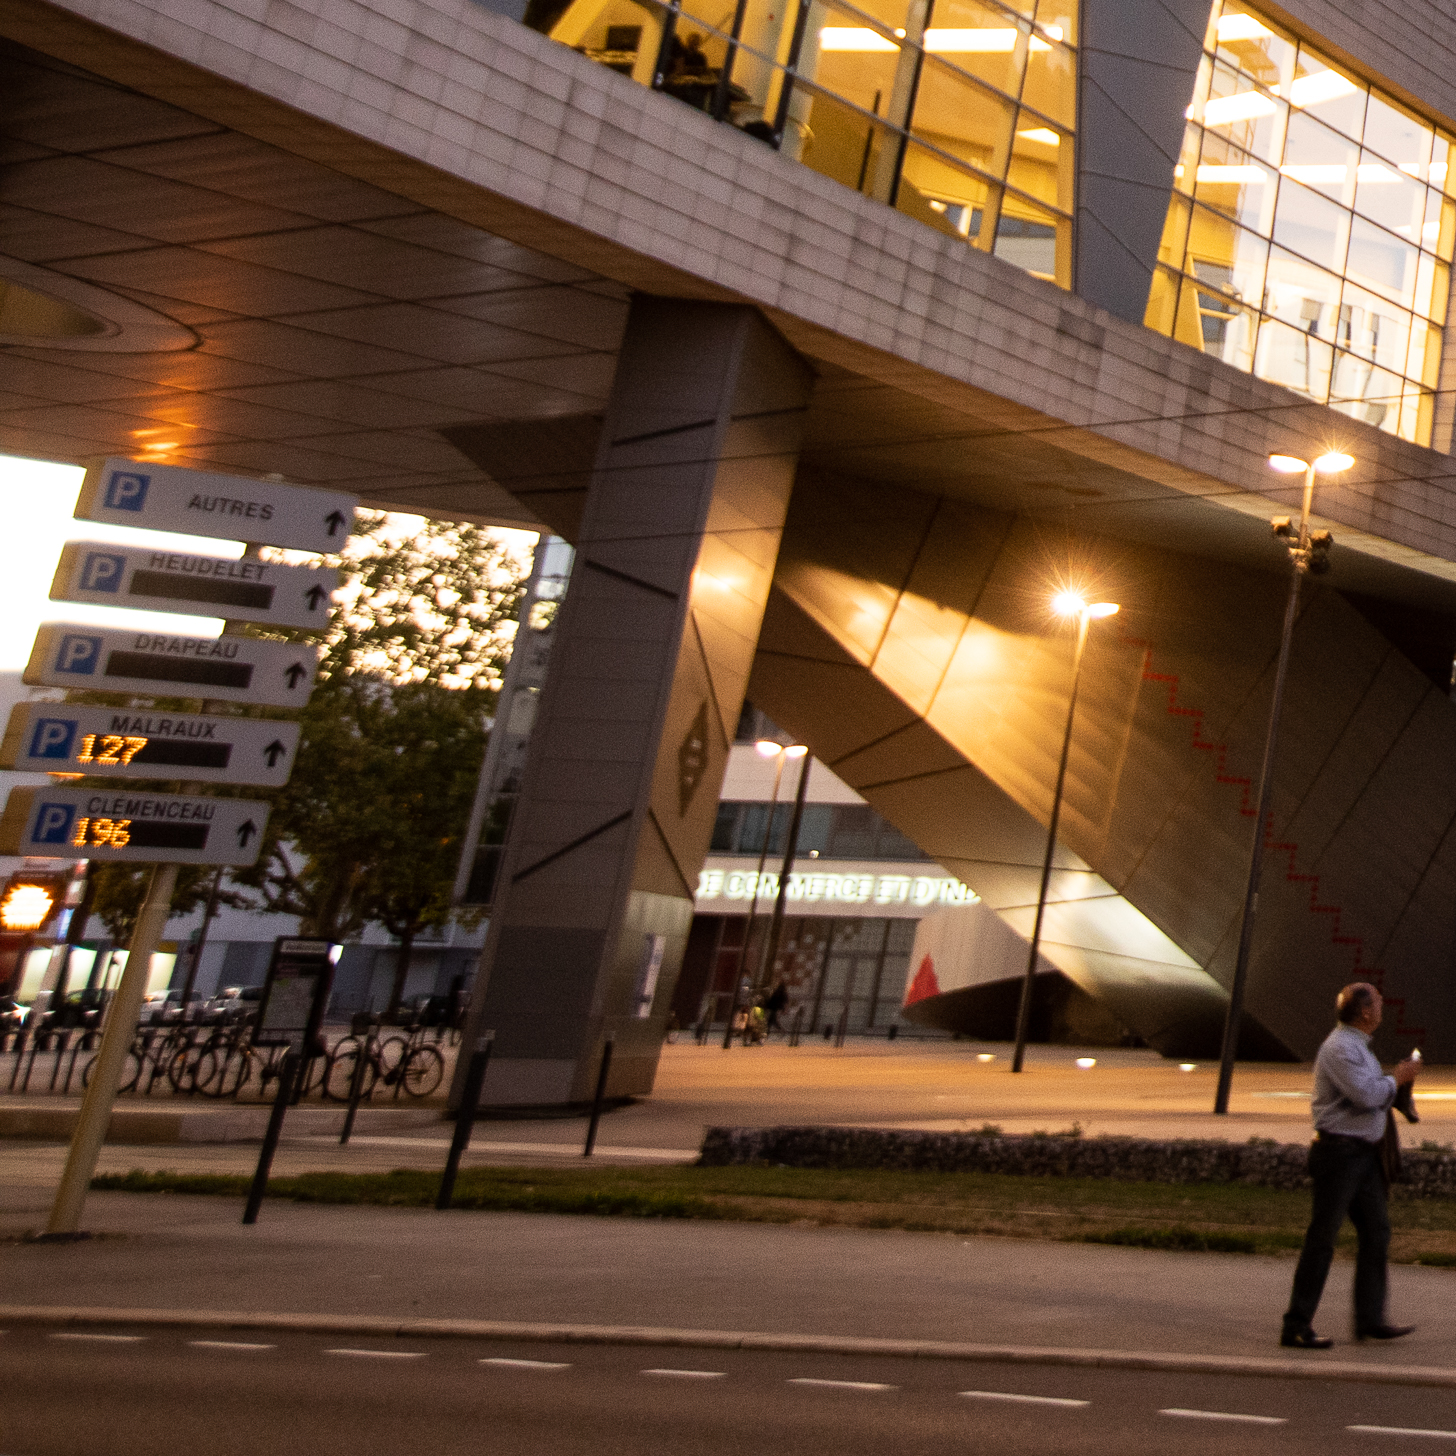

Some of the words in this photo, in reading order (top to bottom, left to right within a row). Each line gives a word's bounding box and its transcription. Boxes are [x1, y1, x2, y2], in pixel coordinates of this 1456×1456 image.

[112, 475, 142, 507] P
[188, 493, 275, 520] AUTRES
[88, 555, 117, 589] P
[150, 552, 269, 580] HEUDELET
[63, 638, 95, 670] P
[135, 633, 239, 659] DRAPEAU
[36, 721, 68, 755] P
[110, 715, 217, 740] MALRAUX
[77, 733, 148, 766] 127
[39, 806, 69, 842] P
[87, 795, 215, 821] CLÉMENCEAU
[72, 817, 132, 848] 196
[725, 870, 874, 903] COMMERCE
